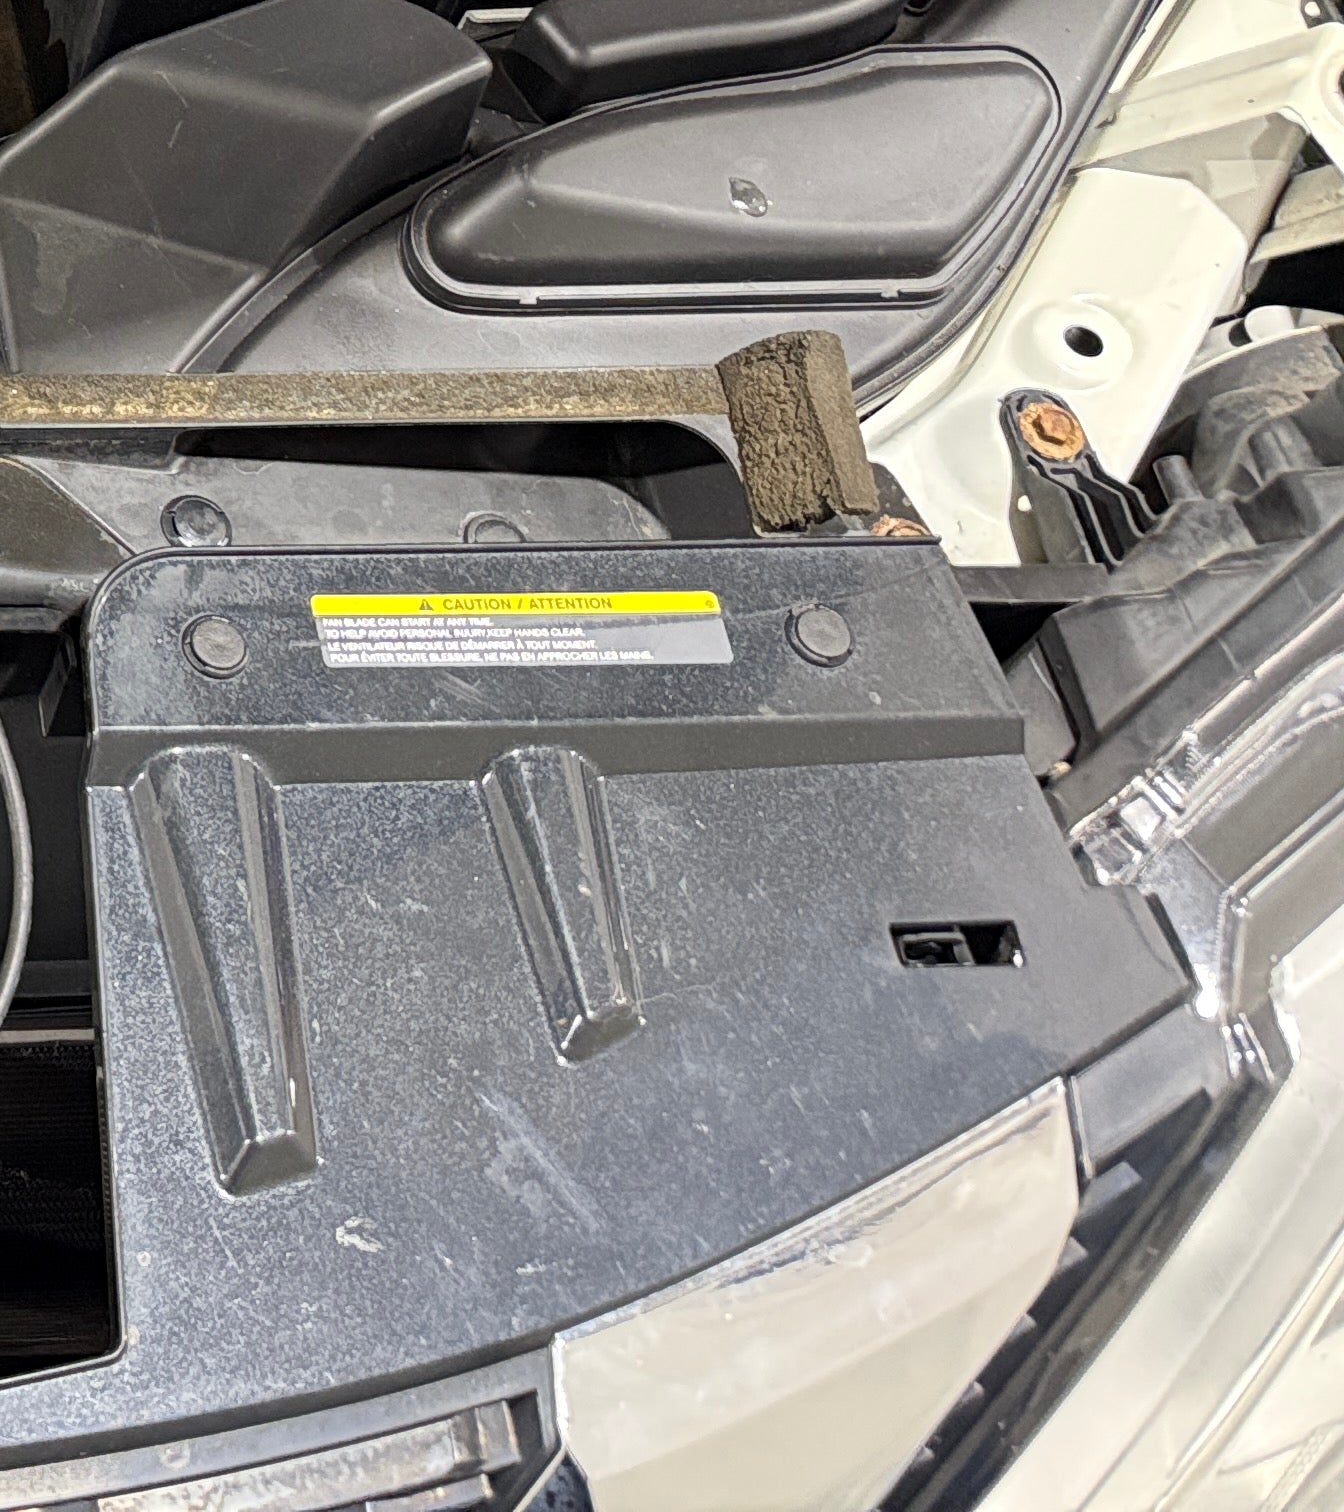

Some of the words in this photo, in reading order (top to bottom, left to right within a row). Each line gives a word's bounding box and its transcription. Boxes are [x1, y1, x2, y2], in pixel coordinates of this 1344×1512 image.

[442, 598, 512, 610] CAUTION
[530, 597, 612, 609] ATTENTION
[323, 618, 342, 627] FAN
[344, 618, 376, 627] BLADE
[378, 618, 400, 626] CAN
[401, 618, 431, 626] START
[432, 618, 446, 626] AT
[447, 618, 467, 626] ANY
[325, 630, 339, 638] TO
[341, 630, 367, 639] HELP
[368, 629, 398, 638] AVOID
[399, 629, 453, 638] PERSONAL
[514, 629, 549, 637] HANDS
[327, 642, 340, 651] LE
[342, 642, 405, 651] VENTILATEUR
[446, 641, 459, 650] DE
[460, 639, 514, 650] DÉMARRER
[526, 640, 551, 649] TOUT
[330, 654, 361, 663] POUR
[396, 653, 429, 662] TOUTE
[485, 652, 498, 661] NE
[500, 652, 521, 661] PAS
[521, 652, 536, 661] EN
[537, 651, 597, 661] APPROCHER
[599, 650, 618, 660] LES
